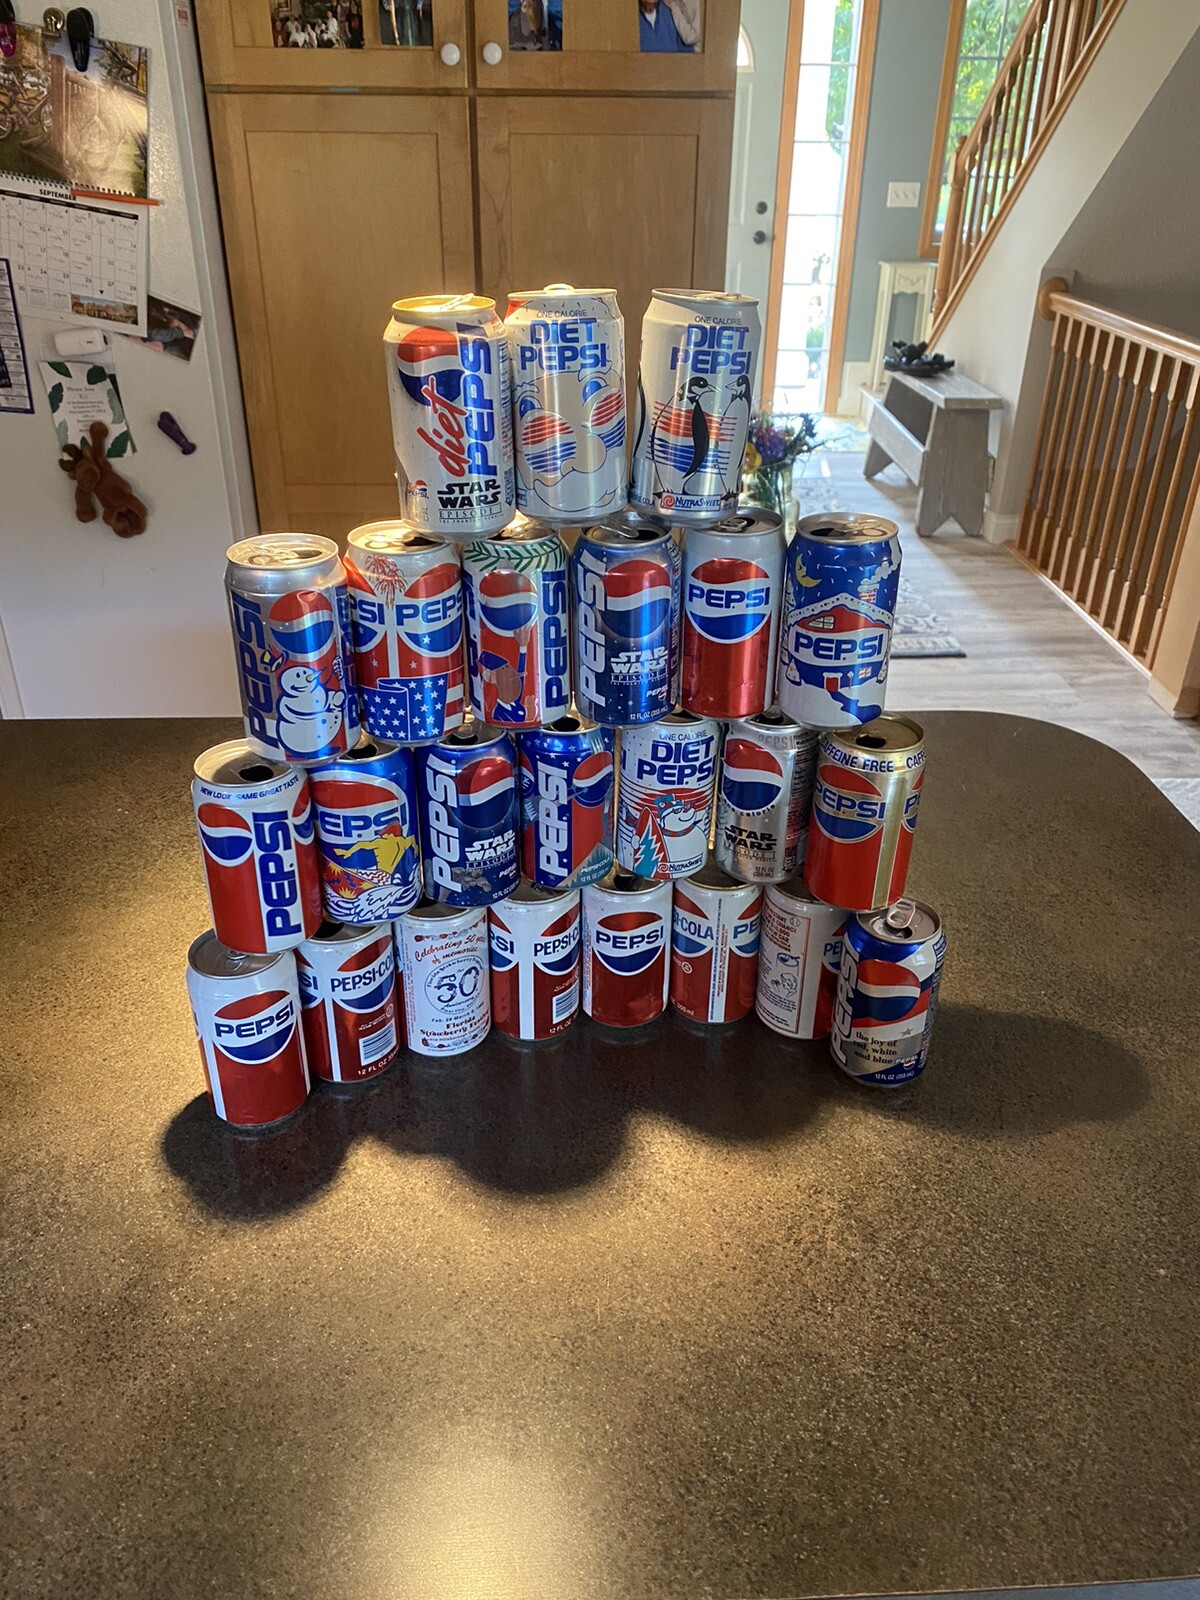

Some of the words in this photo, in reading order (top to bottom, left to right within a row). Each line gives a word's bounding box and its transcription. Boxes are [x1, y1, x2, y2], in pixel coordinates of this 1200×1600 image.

[39, 188, 77, 201] SEPTEMBER
[537, 310, 552, 318] ONE
[554, 309, 588, 318] CALORIE
[694, 316, 711, 324] ONE
[712, 317, 742, 326] CALORIE
[529, 317, 597, 344] DIET
[686, 324, 750, 350] DIET
[520, 343, 606, 371] PEPSI
[670, 347, 752, 375] PEPSI
[456, 321, 498, 477] PEPSI
[416, 374, 471, 478] diet
[437, 479, 501, 495] STAR
[437, 491, 502, 509] WARS
[439, 506, 494, 519] EPISODE
[689, 583, 770, 609] PEPSI
[542, 569, 569, 708] PEPSI
[577, 549, 607, 708] PEPSI
[610, 646, 668, 662] STAR
[794, 631, 884, 660] PEPSI
[231, 592, 280, 749] PEPSI
[610, 656, 668, 674] WARS
[677, 730, 708, 740] CALORIE
[651, 735, 714, 763] DIET
[637, 754, 717, 786] PEPSI
[862, 759, 894, 772] FREE
[200, 786, 212, 796] NEW
[213, 792, 231, 800] LOOK
[259, 786, 282, 798] GREAT
[284, 775, 299, 790] TASTE
[426, 753, 462, 893] PEPSI
[537, 760, 568, 877] PEPSI
[740, 804, 775, 817] calorie
[465, 830, 516, 852] STAR
[724, 825, 777, 842] STAR
[724, 830, 777, 851] WARS
[466, 837, 516, 861] WARS
[252, 810, 302, 936] PEPSI
[596, 925, 664, 949] PEPSI
[434, 966, 479, 1003] 50
[830, 931, 860, 1066] PEPSI
[214, 1000, 294, 1038] PEPSI
[856, 1032, 869, 1042] the
[871, 1037, 885, 1047] joy
[378, 1058, 387, 1067] OZ
[854, 1051, 870, 1060] and
